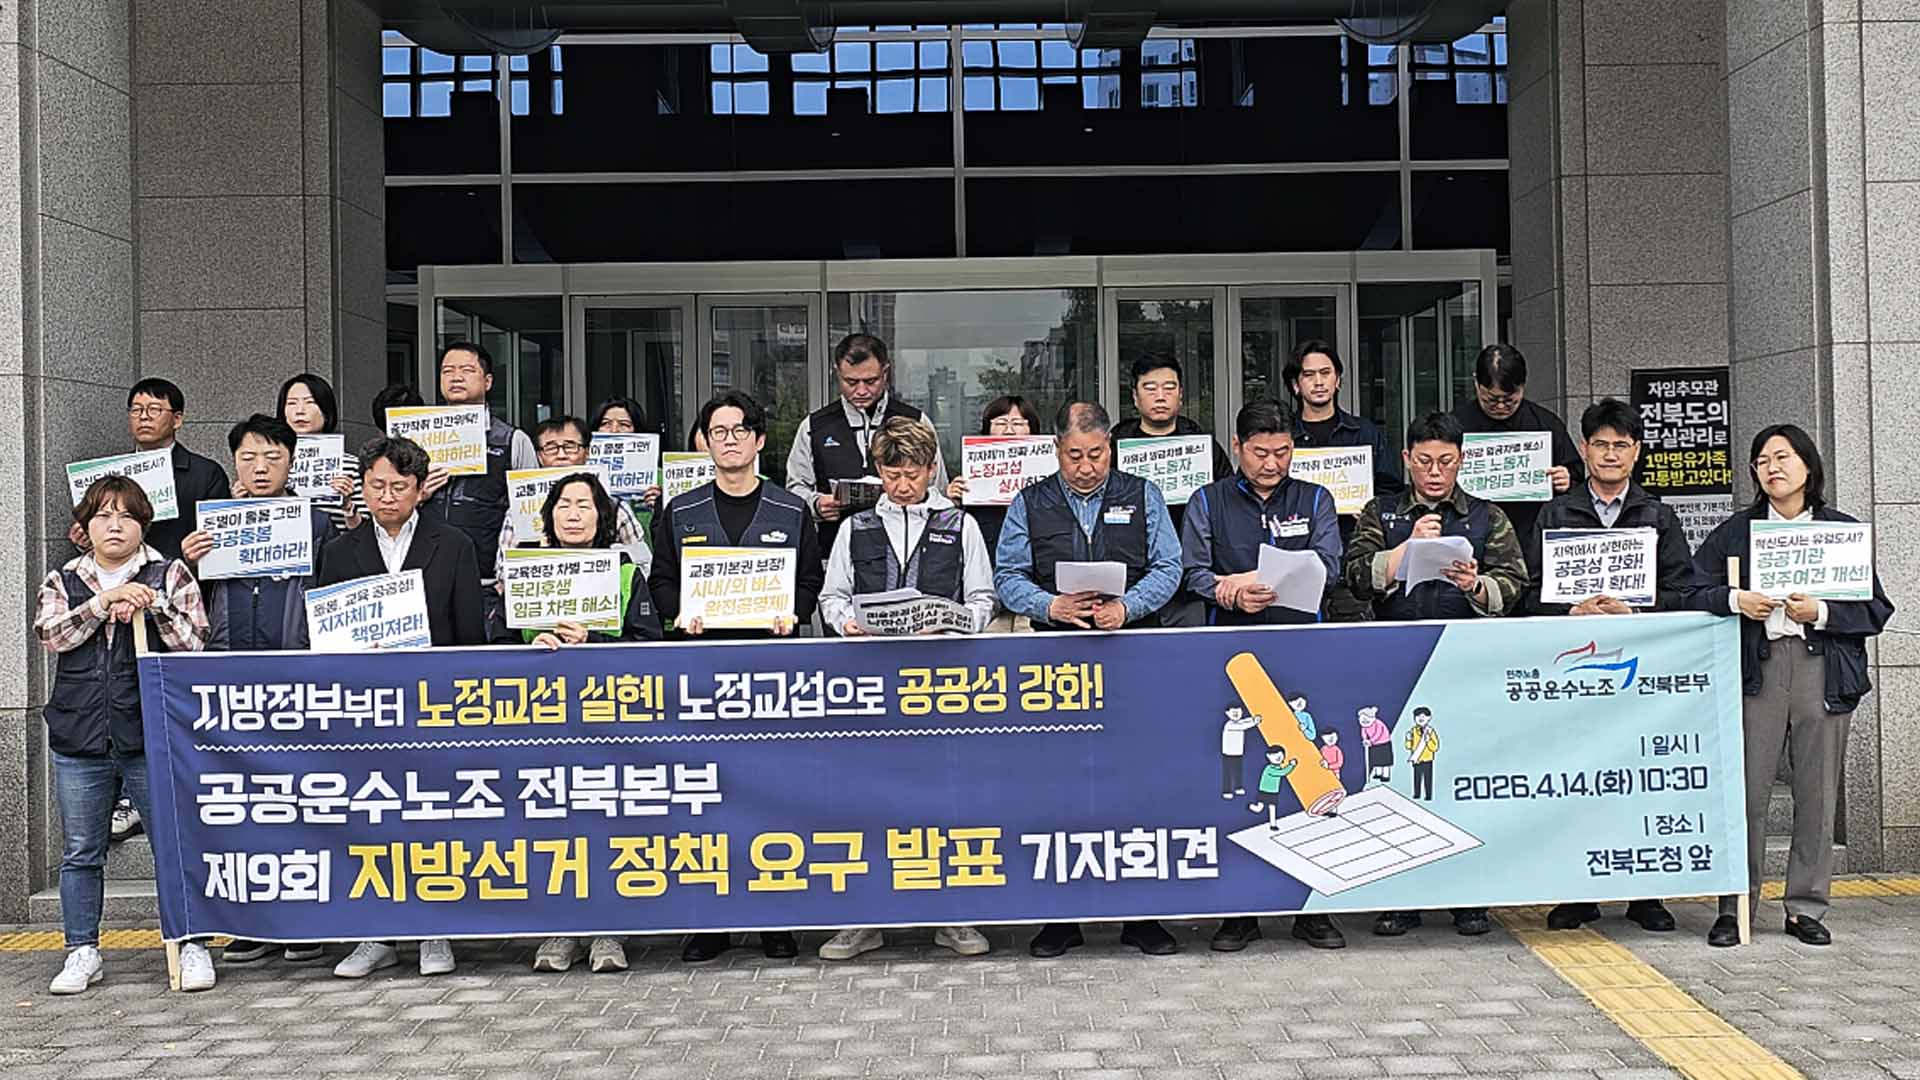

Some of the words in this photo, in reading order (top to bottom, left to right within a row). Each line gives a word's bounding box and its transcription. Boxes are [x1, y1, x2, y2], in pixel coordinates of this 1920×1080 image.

[1647, 380, 1719, 398] 자임추모관
[1640, 400, 1728, 427] 전북도의
[1642, 426, 1728, 449] 부실관리로
[968, 459, 1022, 480] 노정교섭
[1489, 454, 1531, 472] 노동자
[1645, 450, 1728, 469] 1만명유가족
[609, 472, 654, 488] 대하라!
[1640, 468, 1732, 487] 고통받고있다!
[1552, 543, 1597, 558] 지역에서
[1600, 538, 1644, 555] 실현하는
[1755, 534, 1809, 550] 혁신도시는
[1812, 531, 1864, 546] 유럽도시?
[239, 541, 308, 565] 확대하라!
[1757, 547, 1825, 569] 공공기관
[507, 564, 554, 580] 교육현장
[556, 561, 581, 576] 차별
[583, 559, 612, 573] 그만!
[689, 559, 753, 578] 교통기본권
[755, 556, 786, 573] 보장!
[1555, 557, 1602, 578] 공공성
[1608, 553, 1644, 573] 강화!
[1760, 566, 1826, 589] 정주여건
[1832, 564, 1870, 583] 개선!
[511, 578, 572, 598] 복리후생
[690, 577, 748, 599] 시내/외
[752, 574, 783, 593] 버스
[1555, 577, 1605, 596] 노동권
[1608, 573, 1646, 592] 확대!
[317, 600, 385, 635] 지자체가
[513, 601, 543, 619] 임금
[546, 598, 577, 616] 차별
[581, 593, 618, 614] 해소!
[351, 612, 424, 643] 책임져라!
[1505, 668, 1541, 680] 민주노총
[191, 682, 405, 732] 지방정부부터
[416, 676, 567, 728] 노정교섭
[578, 673, 666, 723] 실현!
[678, 671, 887, 721] 노정교섭으로
[897, 665, 1007, 716] 공공성
[1018, 662, 1104, 712] 강화!
[1505, 678, 1616, 701] 공공운수노조
[1637, 673, 1711, 695] 전북본부
[1652, 736, 1688, 754] 일시
[196, 771, 506, 825] 공공운수노조
[517, 763, 722, 819] 전북본부
[1454, 768, 1633, 801] 2026.4.14.(화)
[1640, 766, 1709, 793] 10:30
[1655, 814, 1694, 835] 장소
[202, 849, 331, 904] 제9회
[347, 837, 589, 902] 지방선거
[608, 832, 730, 898] 정책
[747, 831, 869, 893] 요구
[886, 827, 1007, 890] 발표
[1020, 826, 1220, 884] 기자회견
[1586, 845, 1684, 877] 전북도청
[1687, 844, 1713, 873] 앞
